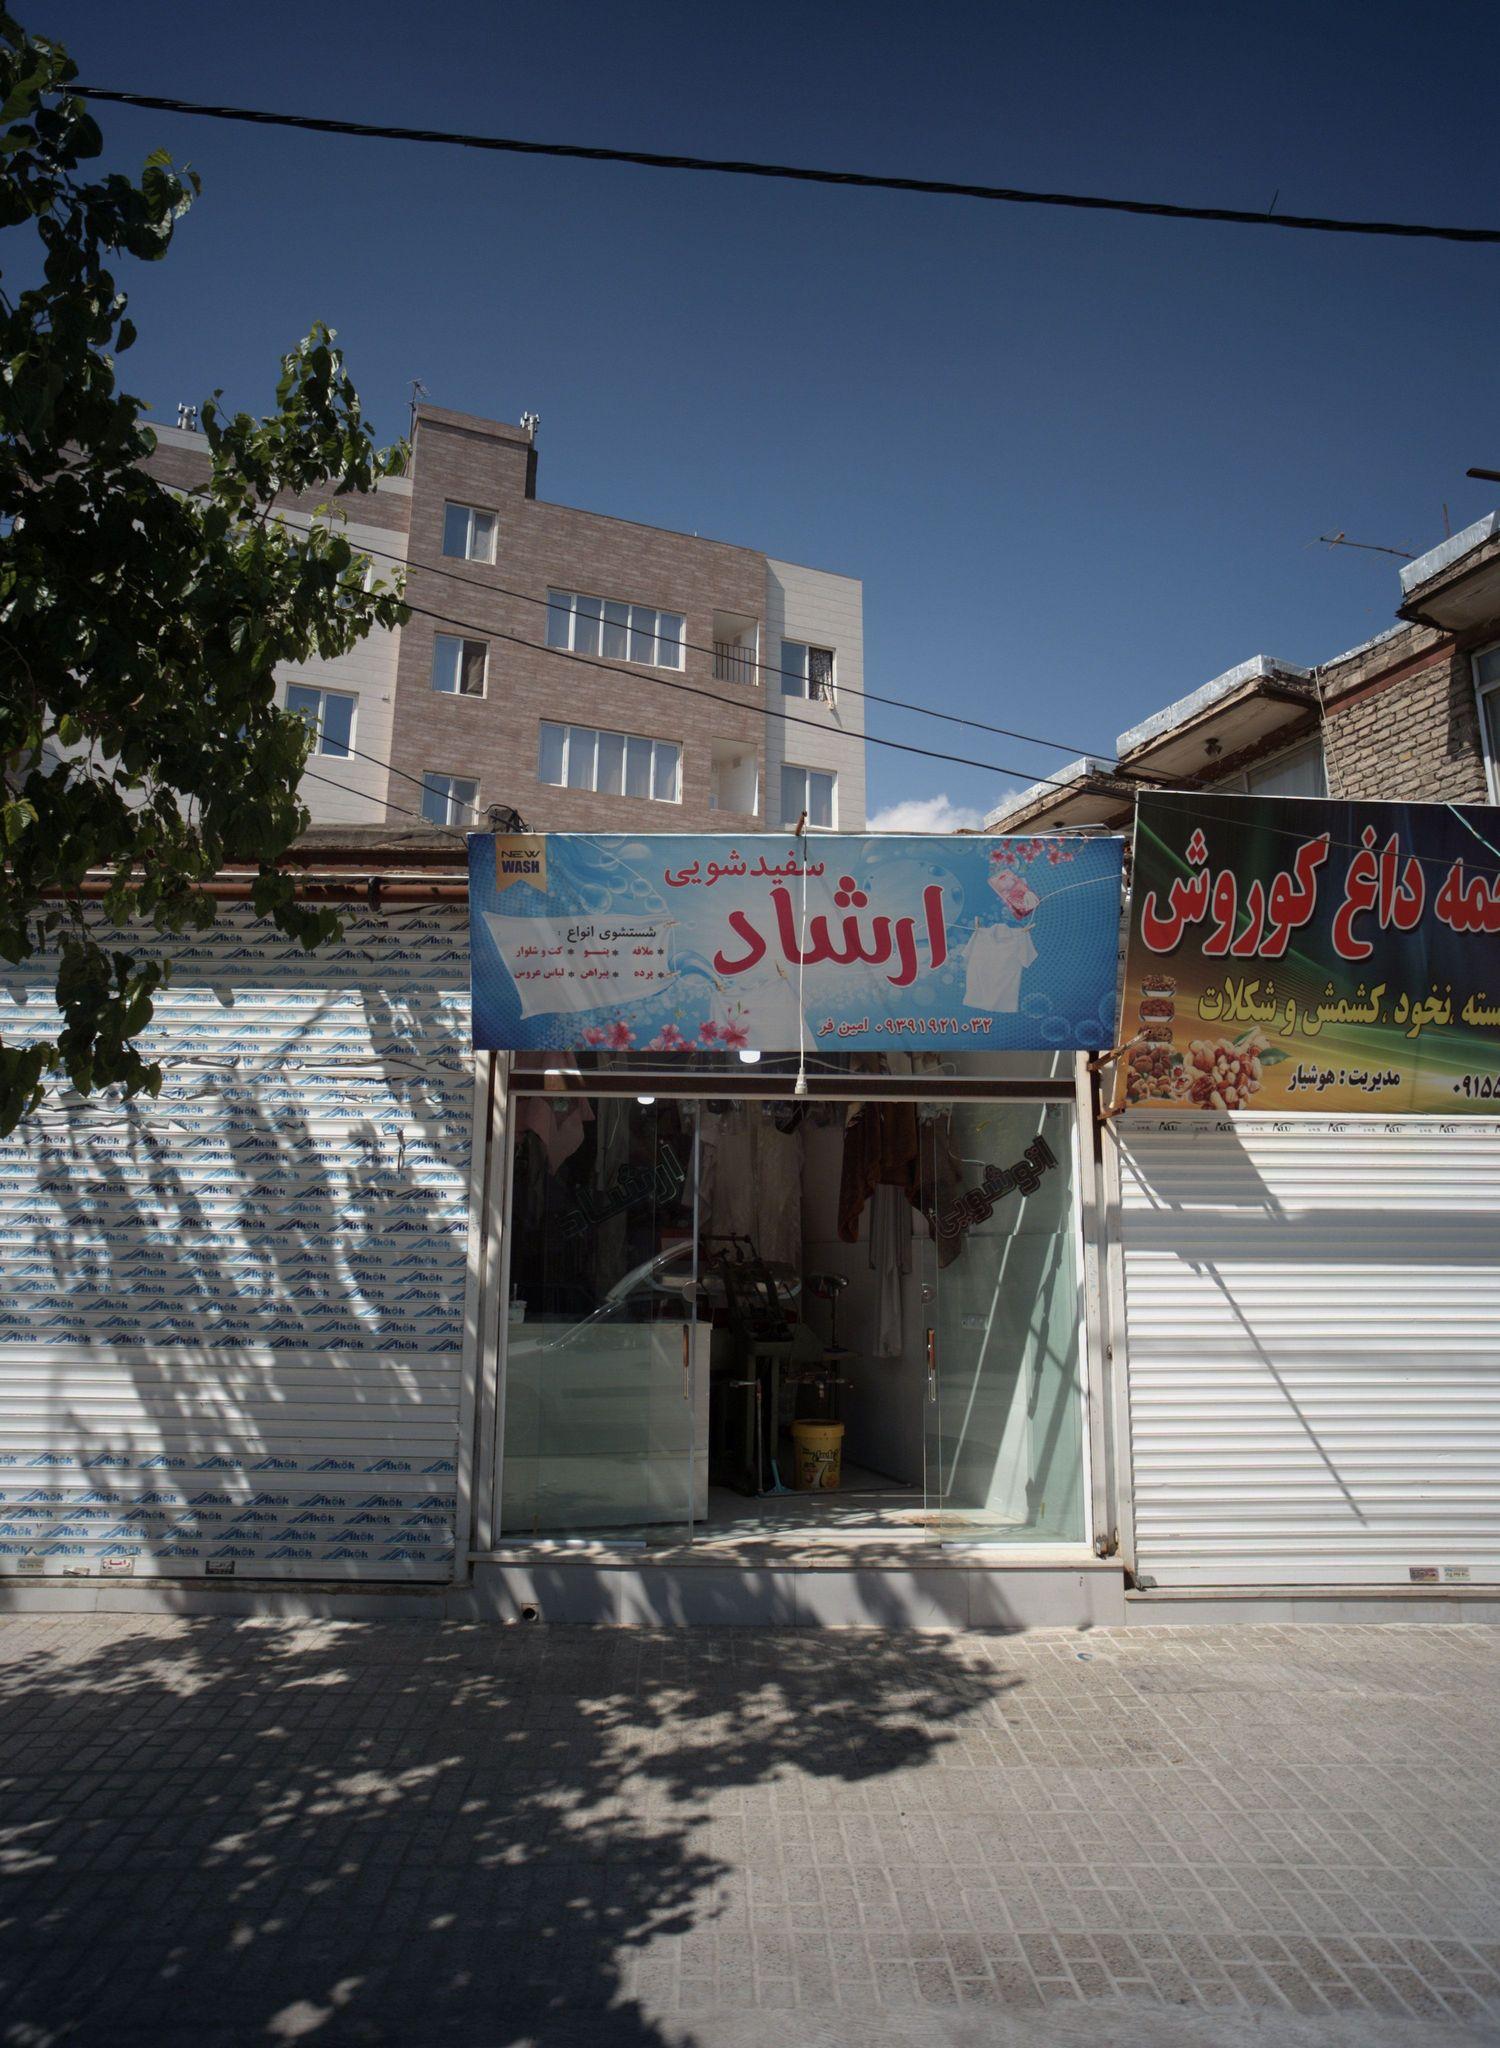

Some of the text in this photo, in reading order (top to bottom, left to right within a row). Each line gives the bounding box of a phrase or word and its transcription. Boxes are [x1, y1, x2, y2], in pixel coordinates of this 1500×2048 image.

[501, 850, 540, 858] NEW
[502, 860, 540, 873] WASH
[1141, 827, 1330, 957] کوروش
[1332, 825, 1425, 959] داغ
[567, 926, 656, 943] شستشوی انواع
[713, 875, 947, 987] ارشاد
[516, 946, 538, 957] شلوار
[514, 969, 541, 979] عروس
[543, 968, 564, 979] لباس
[633, 968, 654, 979] پرده
[1198, 976, 1277, 1022] شکلات
[1279, 997, 1296, 1036] و
[1461, 992, 1500, 1026] سته
[817, 1017, 834, 1036] فر
[838, 1017, 869, 1036] امین
[1287, 1064, 1400, 1091] مدیریت هوشیار
